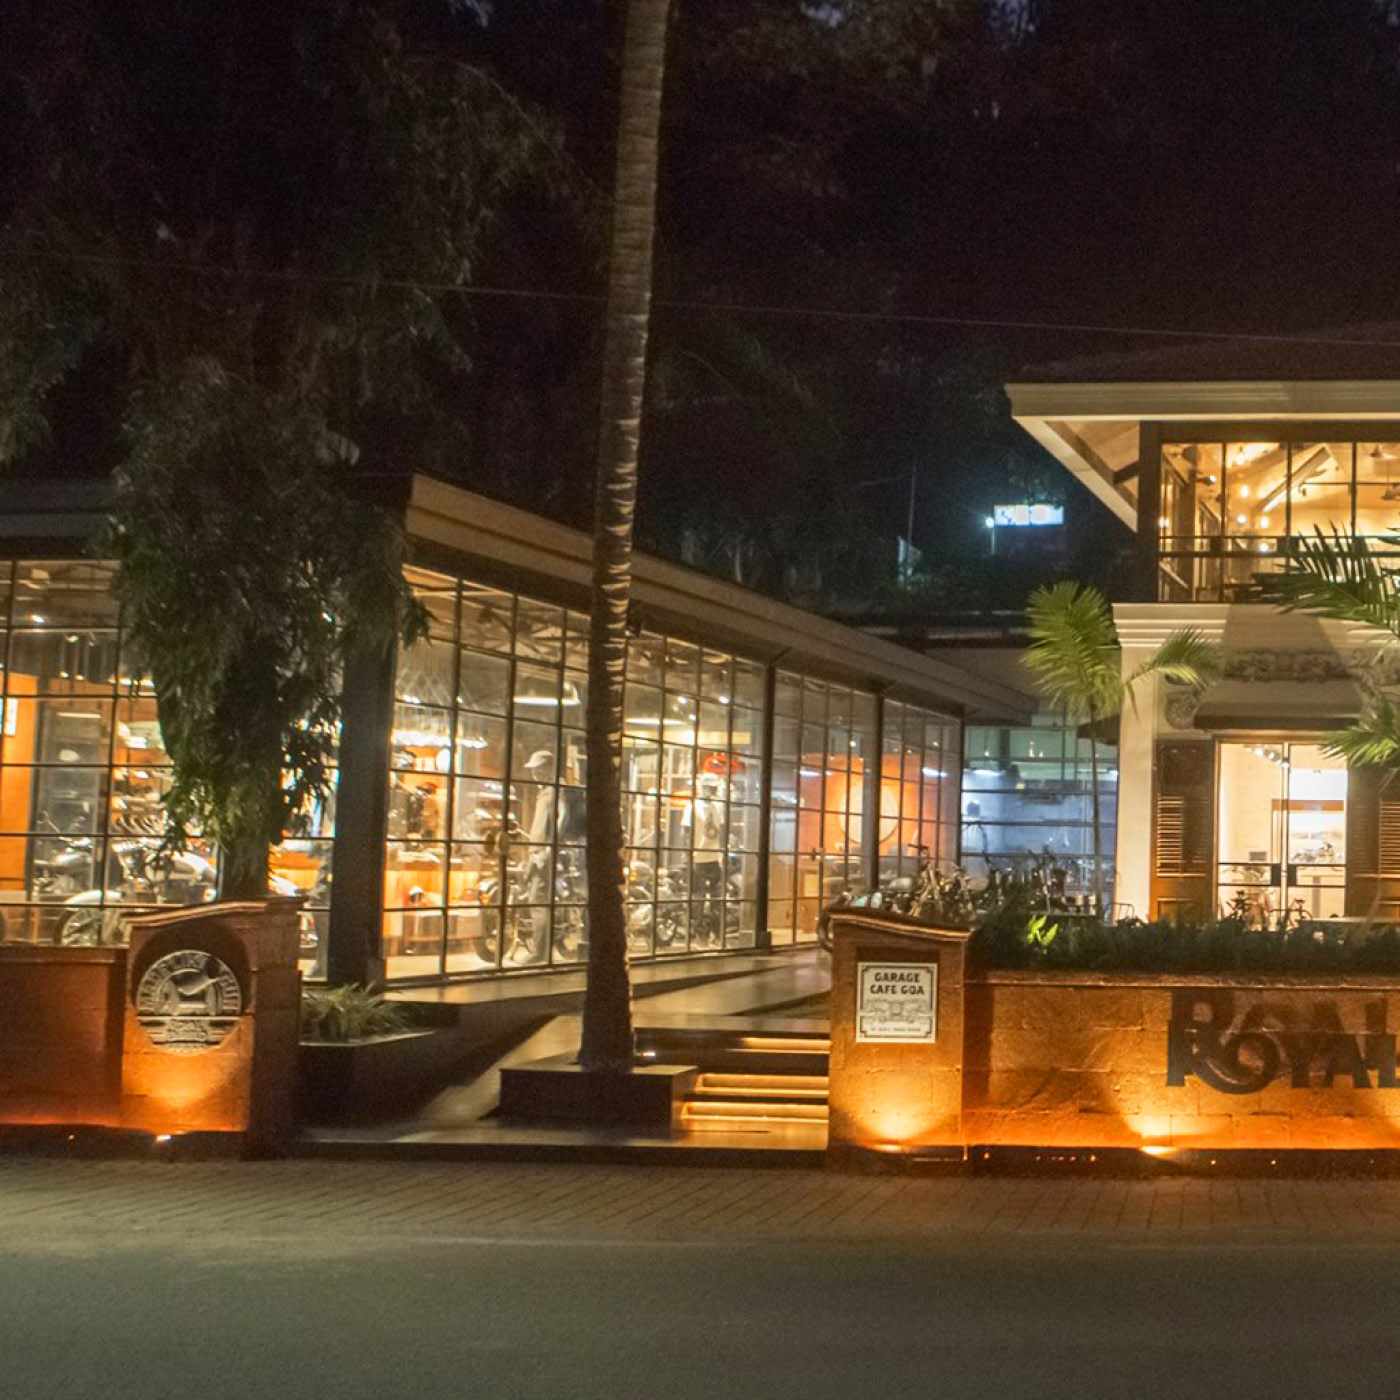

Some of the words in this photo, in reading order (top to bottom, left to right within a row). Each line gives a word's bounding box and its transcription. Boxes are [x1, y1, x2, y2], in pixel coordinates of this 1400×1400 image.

[874, 972, 920, 982] GARAGE
[870, 985, 898, 995] CAFE
[900, 985, 925, 995] GOA
